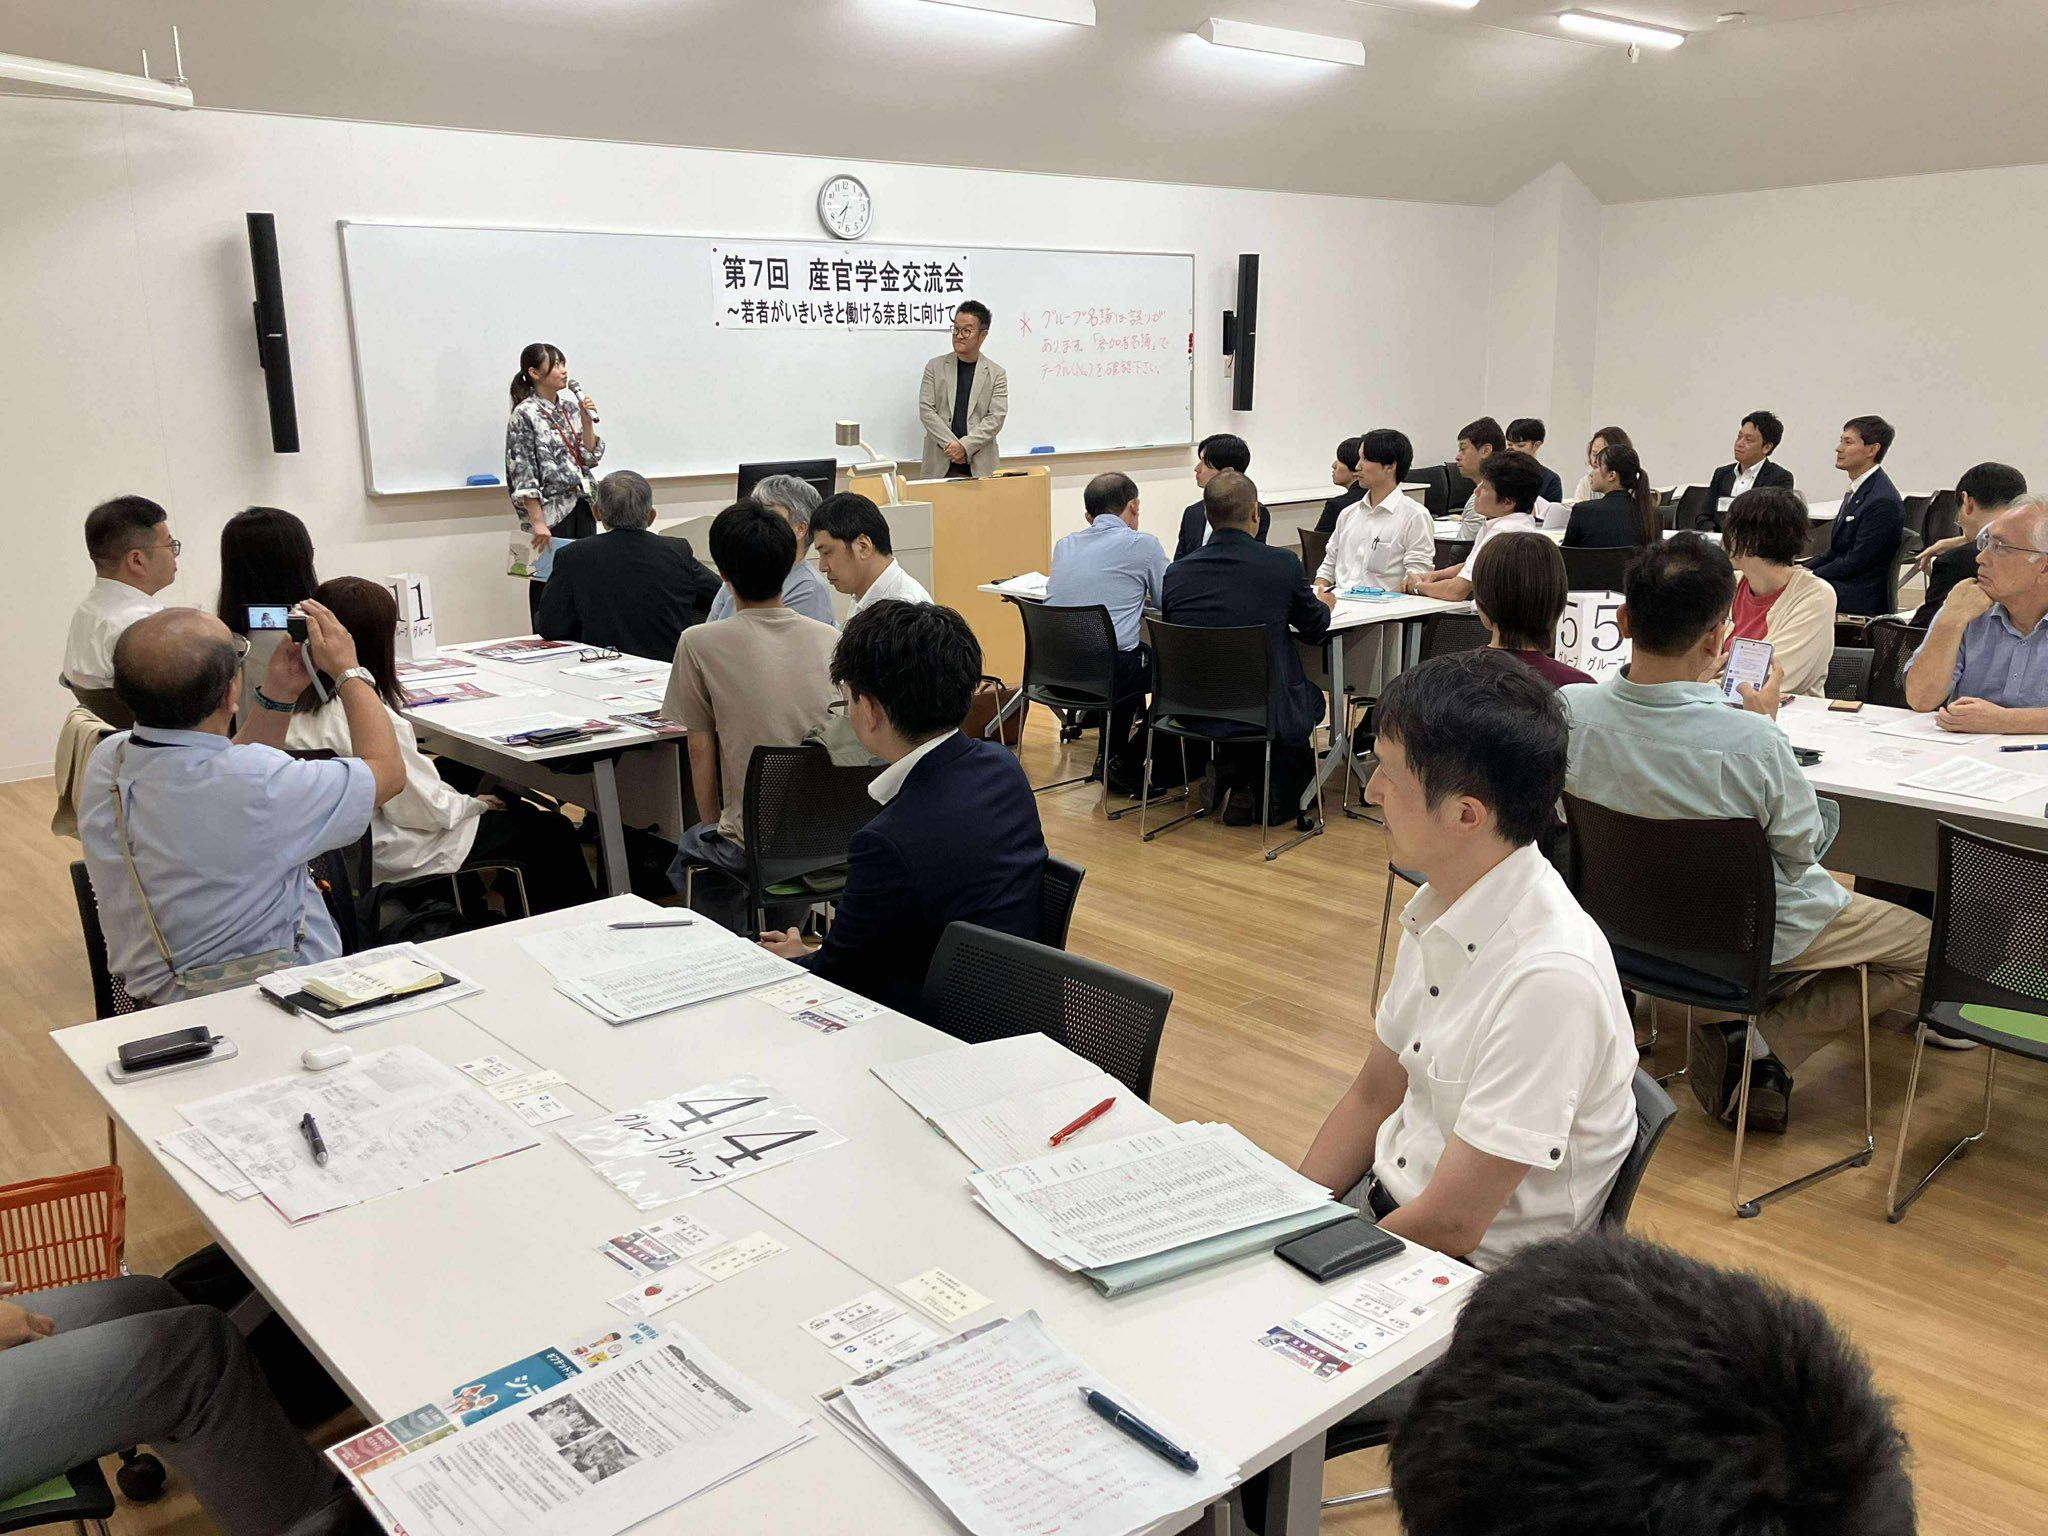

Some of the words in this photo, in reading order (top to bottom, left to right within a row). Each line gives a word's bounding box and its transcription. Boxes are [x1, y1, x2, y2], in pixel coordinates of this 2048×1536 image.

[722, 254, 790, 291] 第7回
[808, 257, 965, 294] 産官学金交流会
[410, 581, 430, 623] 1
[412, 621, 433, 639] グループ
[1560, 601, 1579, 648] 5
[1591, 604, 1624, 652] 5
[614, 1112, 678, 1143] グループ
[668, 1095, 770, 1132] 4
[657, 1148, 727, 1183] グループ
[715, 1129, 819, 1169] 4
